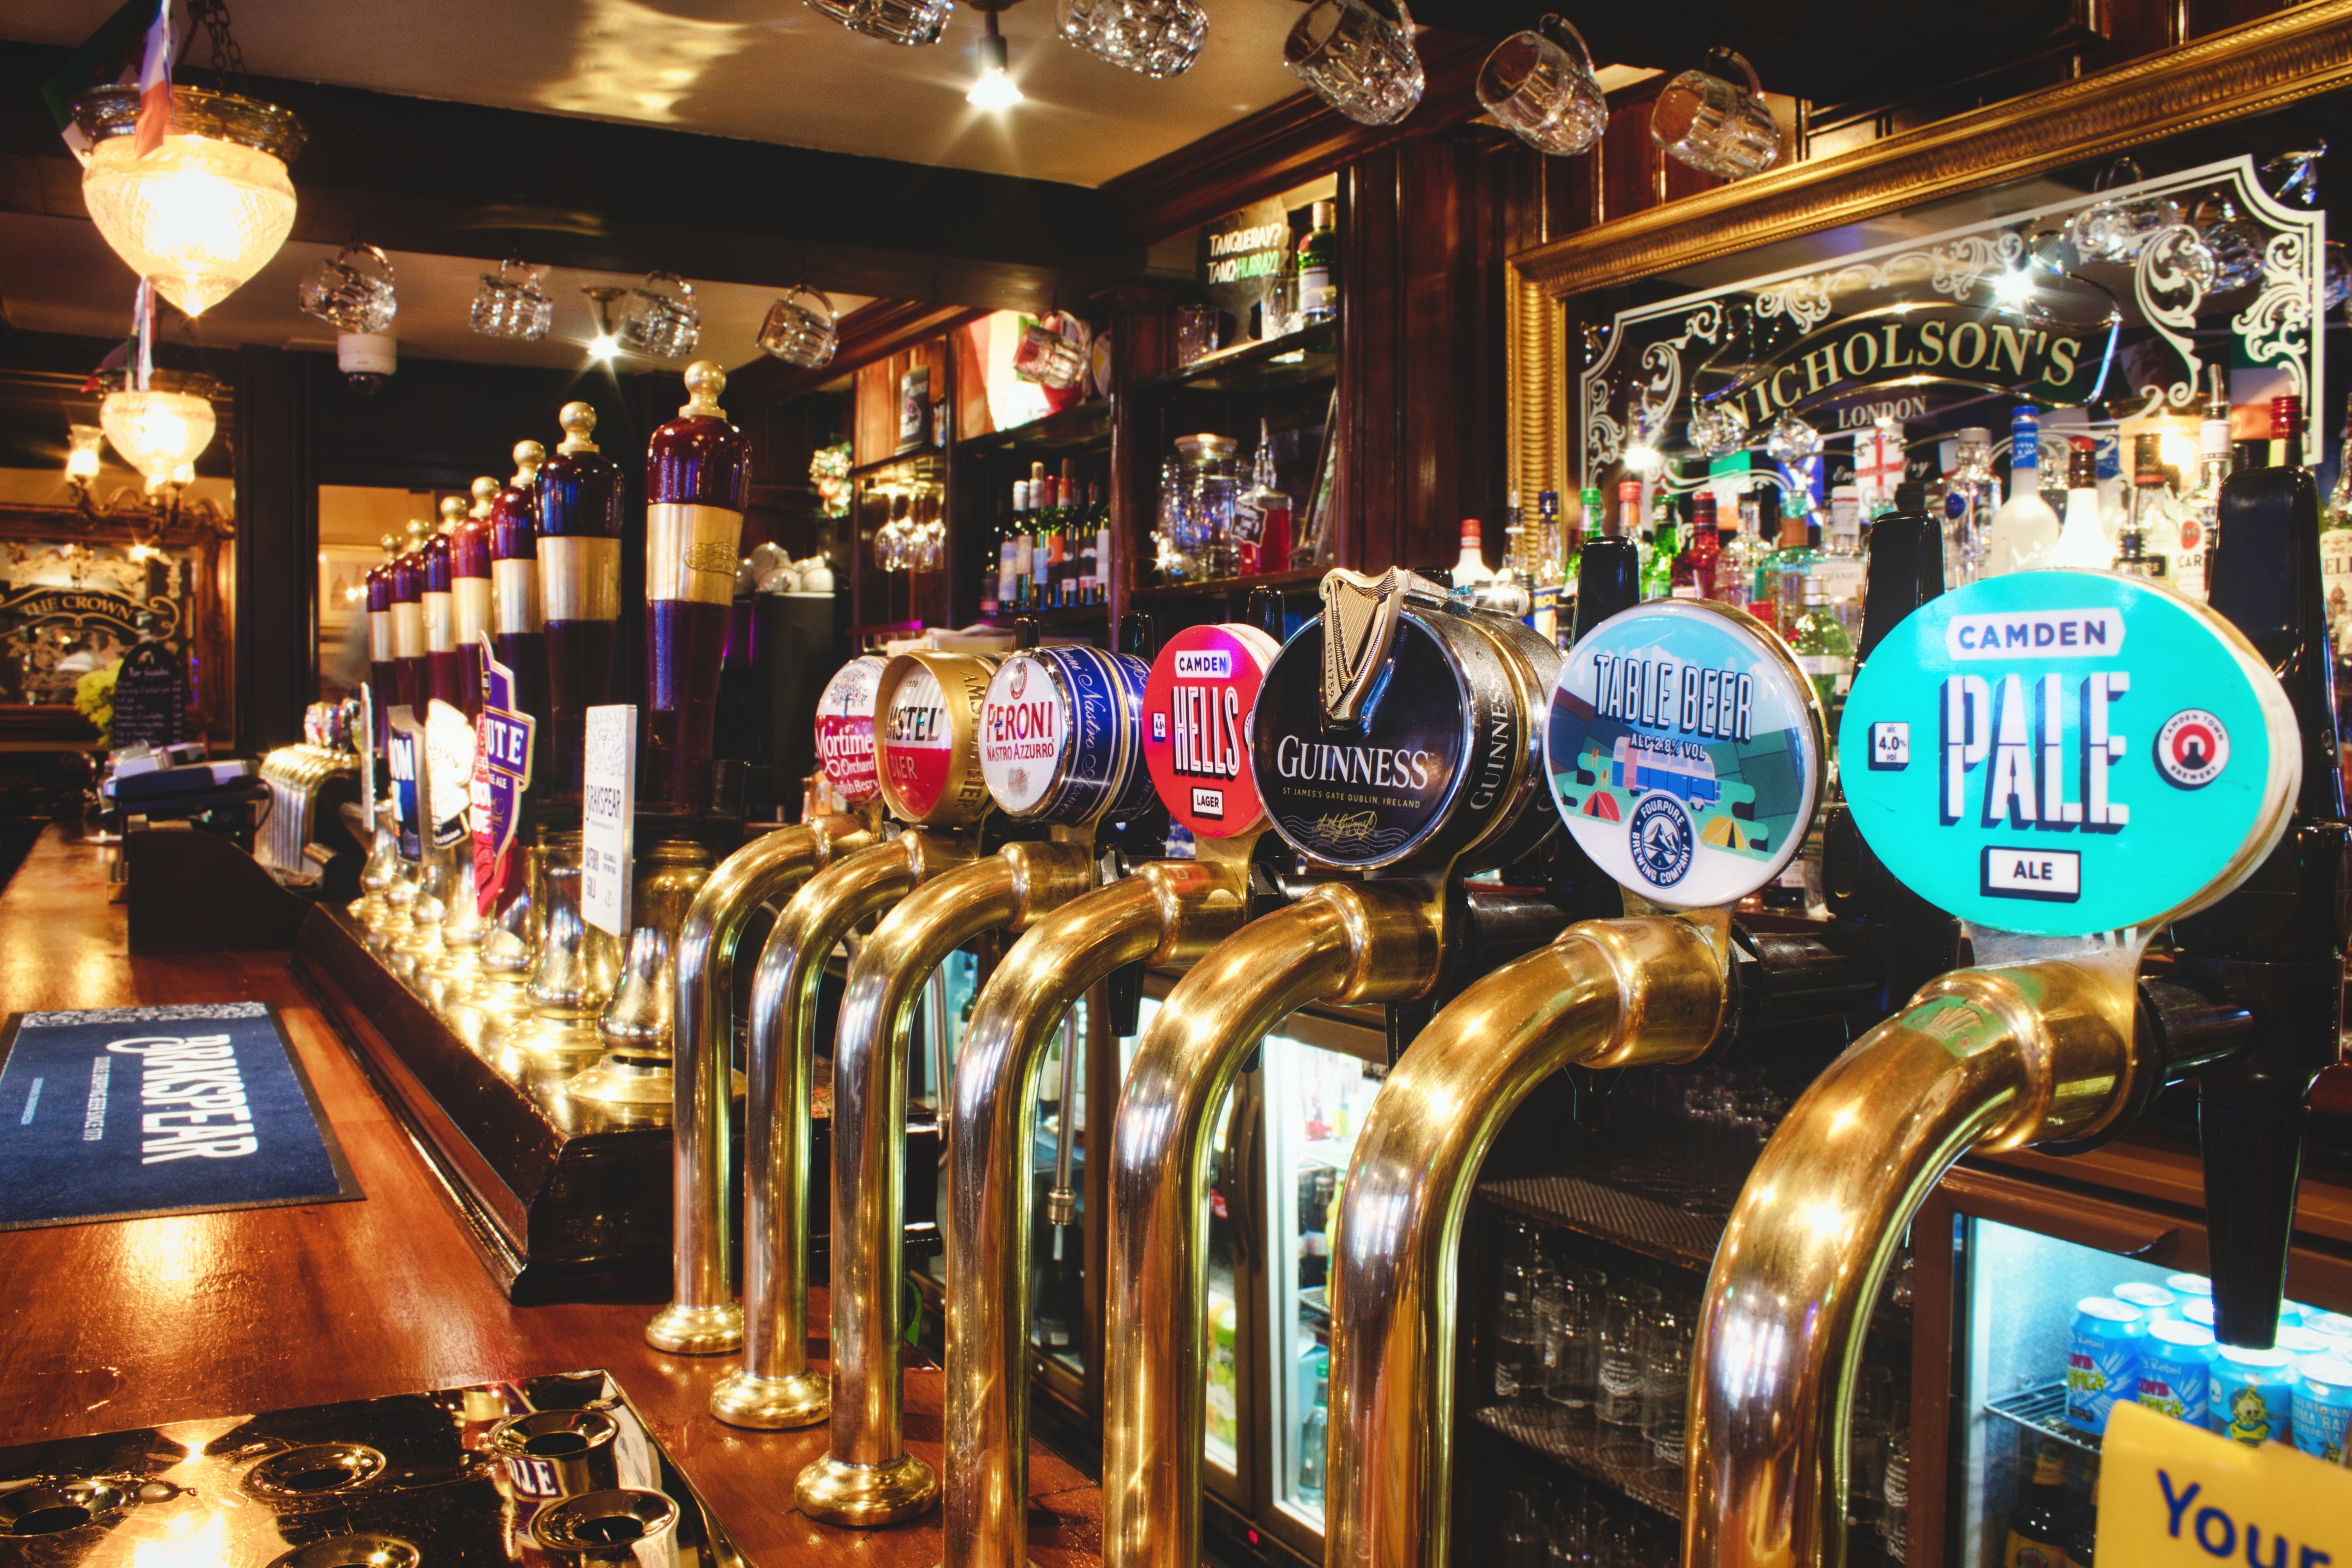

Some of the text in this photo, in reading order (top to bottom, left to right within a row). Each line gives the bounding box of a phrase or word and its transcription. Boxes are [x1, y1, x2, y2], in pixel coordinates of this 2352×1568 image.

[1209, 223, 1282, 257] TANQUERAY?
[1718, 320, 2082, 438] NICHOLSON'S
[1838, 396, 1926, 429] LONDON
[22, 595, 133, 620] THE CROWN
[1957, 619, 2107, 650] CAMDEN
[1179, 657, 1228, 671] CAMDEN
[1078, 673, 1106, 750] Nastro
[1594, 654, 1754, 744] TABLE BEER
[986, 701, 1054, 743] PERONI
[1172, 686, 1240, 779] HELLS
[2164, 714, 2224, 741] CAMDEN TOWN
[815, 726, 875, 762] Mortime
[987, 743, 1054, 762] NASTRO AZZURRO
[1470, 667, 1509, 810] GUINNESS
[1630, 733, 1706, 760] ALC 2.8% VOL
[1879, 736, 1906, 750] 4.0%
[1940, 671, 2130, 834] PALE
[840, 755, 875, 775] Orchard
[889, 755, 919, 781] BIER
[1277, 735, 1429, 790] GUINNESS
[1886, 752, 1896, 760] vol
[2171, 764, 2216, 780] BREWERY
[1196, 794, 1219, 808] LAGER
[1294, 789, 1323, 798] JAMES'S
[1325, 793, 1344, 801] GATE
[1348, 794, 1380, 805] DUBLIN,
[1383, 798, 1421, 808] IRELAND
[1641, 799, 1686, 827] FOURPURE
[1632, 832, 1691, 884] BREWING COMPANY
[2013, 861, 2053, 881] ALE
[107, 1034, 259, 1165] BRAKSPEAR
[2157, 1469, 2333, 1568] Your
